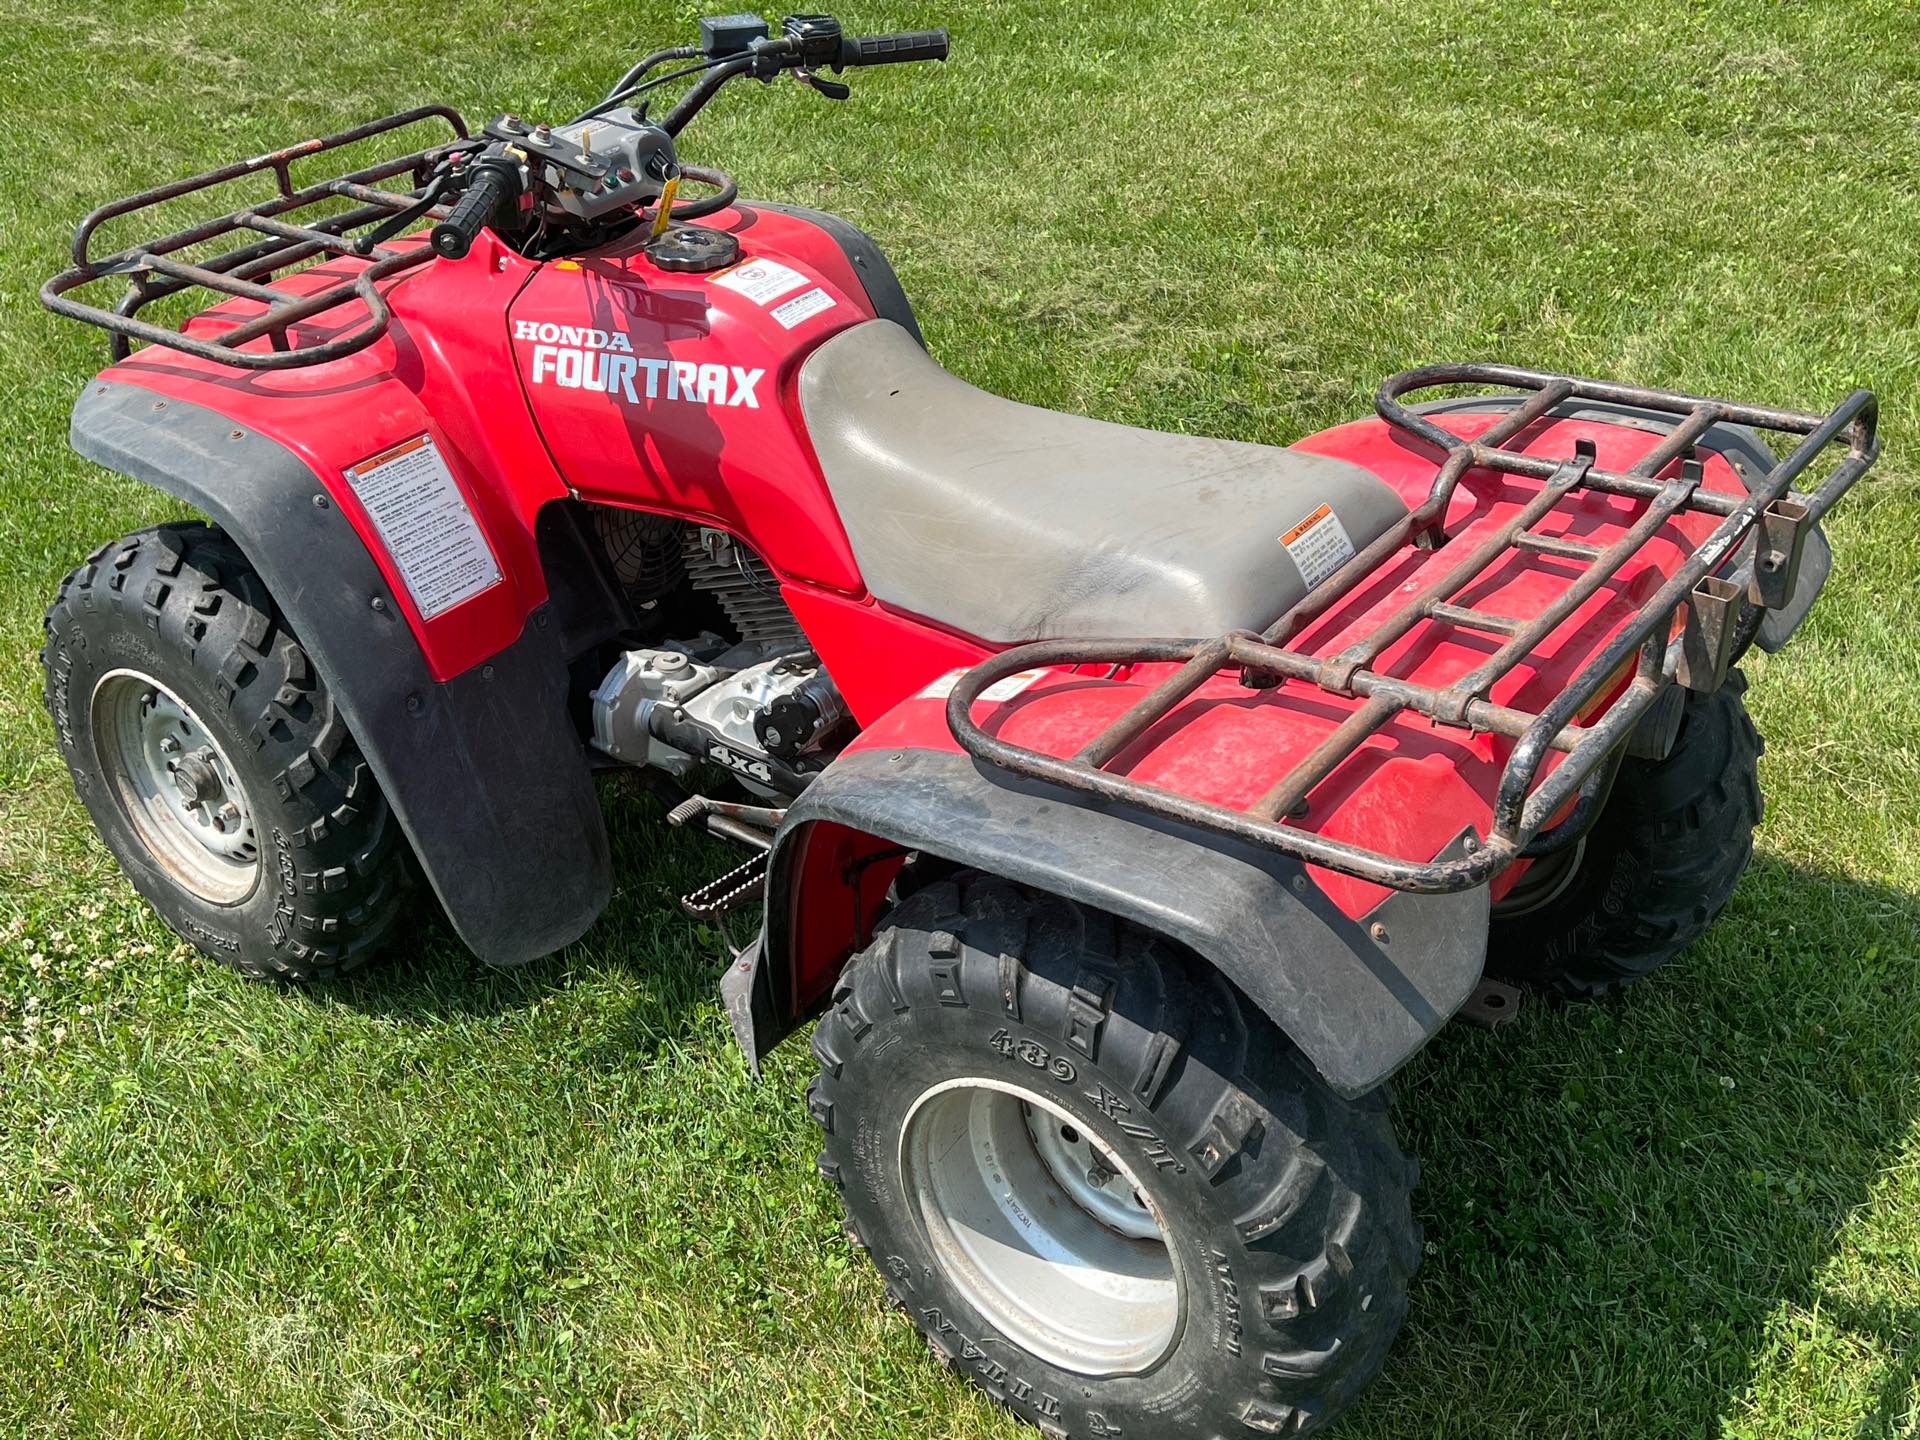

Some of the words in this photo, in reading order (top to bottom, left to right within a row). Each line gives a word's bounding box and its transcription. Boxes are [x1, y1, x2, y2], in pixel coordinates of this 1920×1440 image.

[514, 320, 633, 353] HONDA
[532, 344, 765, 409] FOURTRAX
[709, 745, 772, 782] 4x4
[990, 1027, 1078, 1085] 489
[1084, 1081, 1187, 1175] X/T
[920, 1307, 1062, 1421] TITAN
